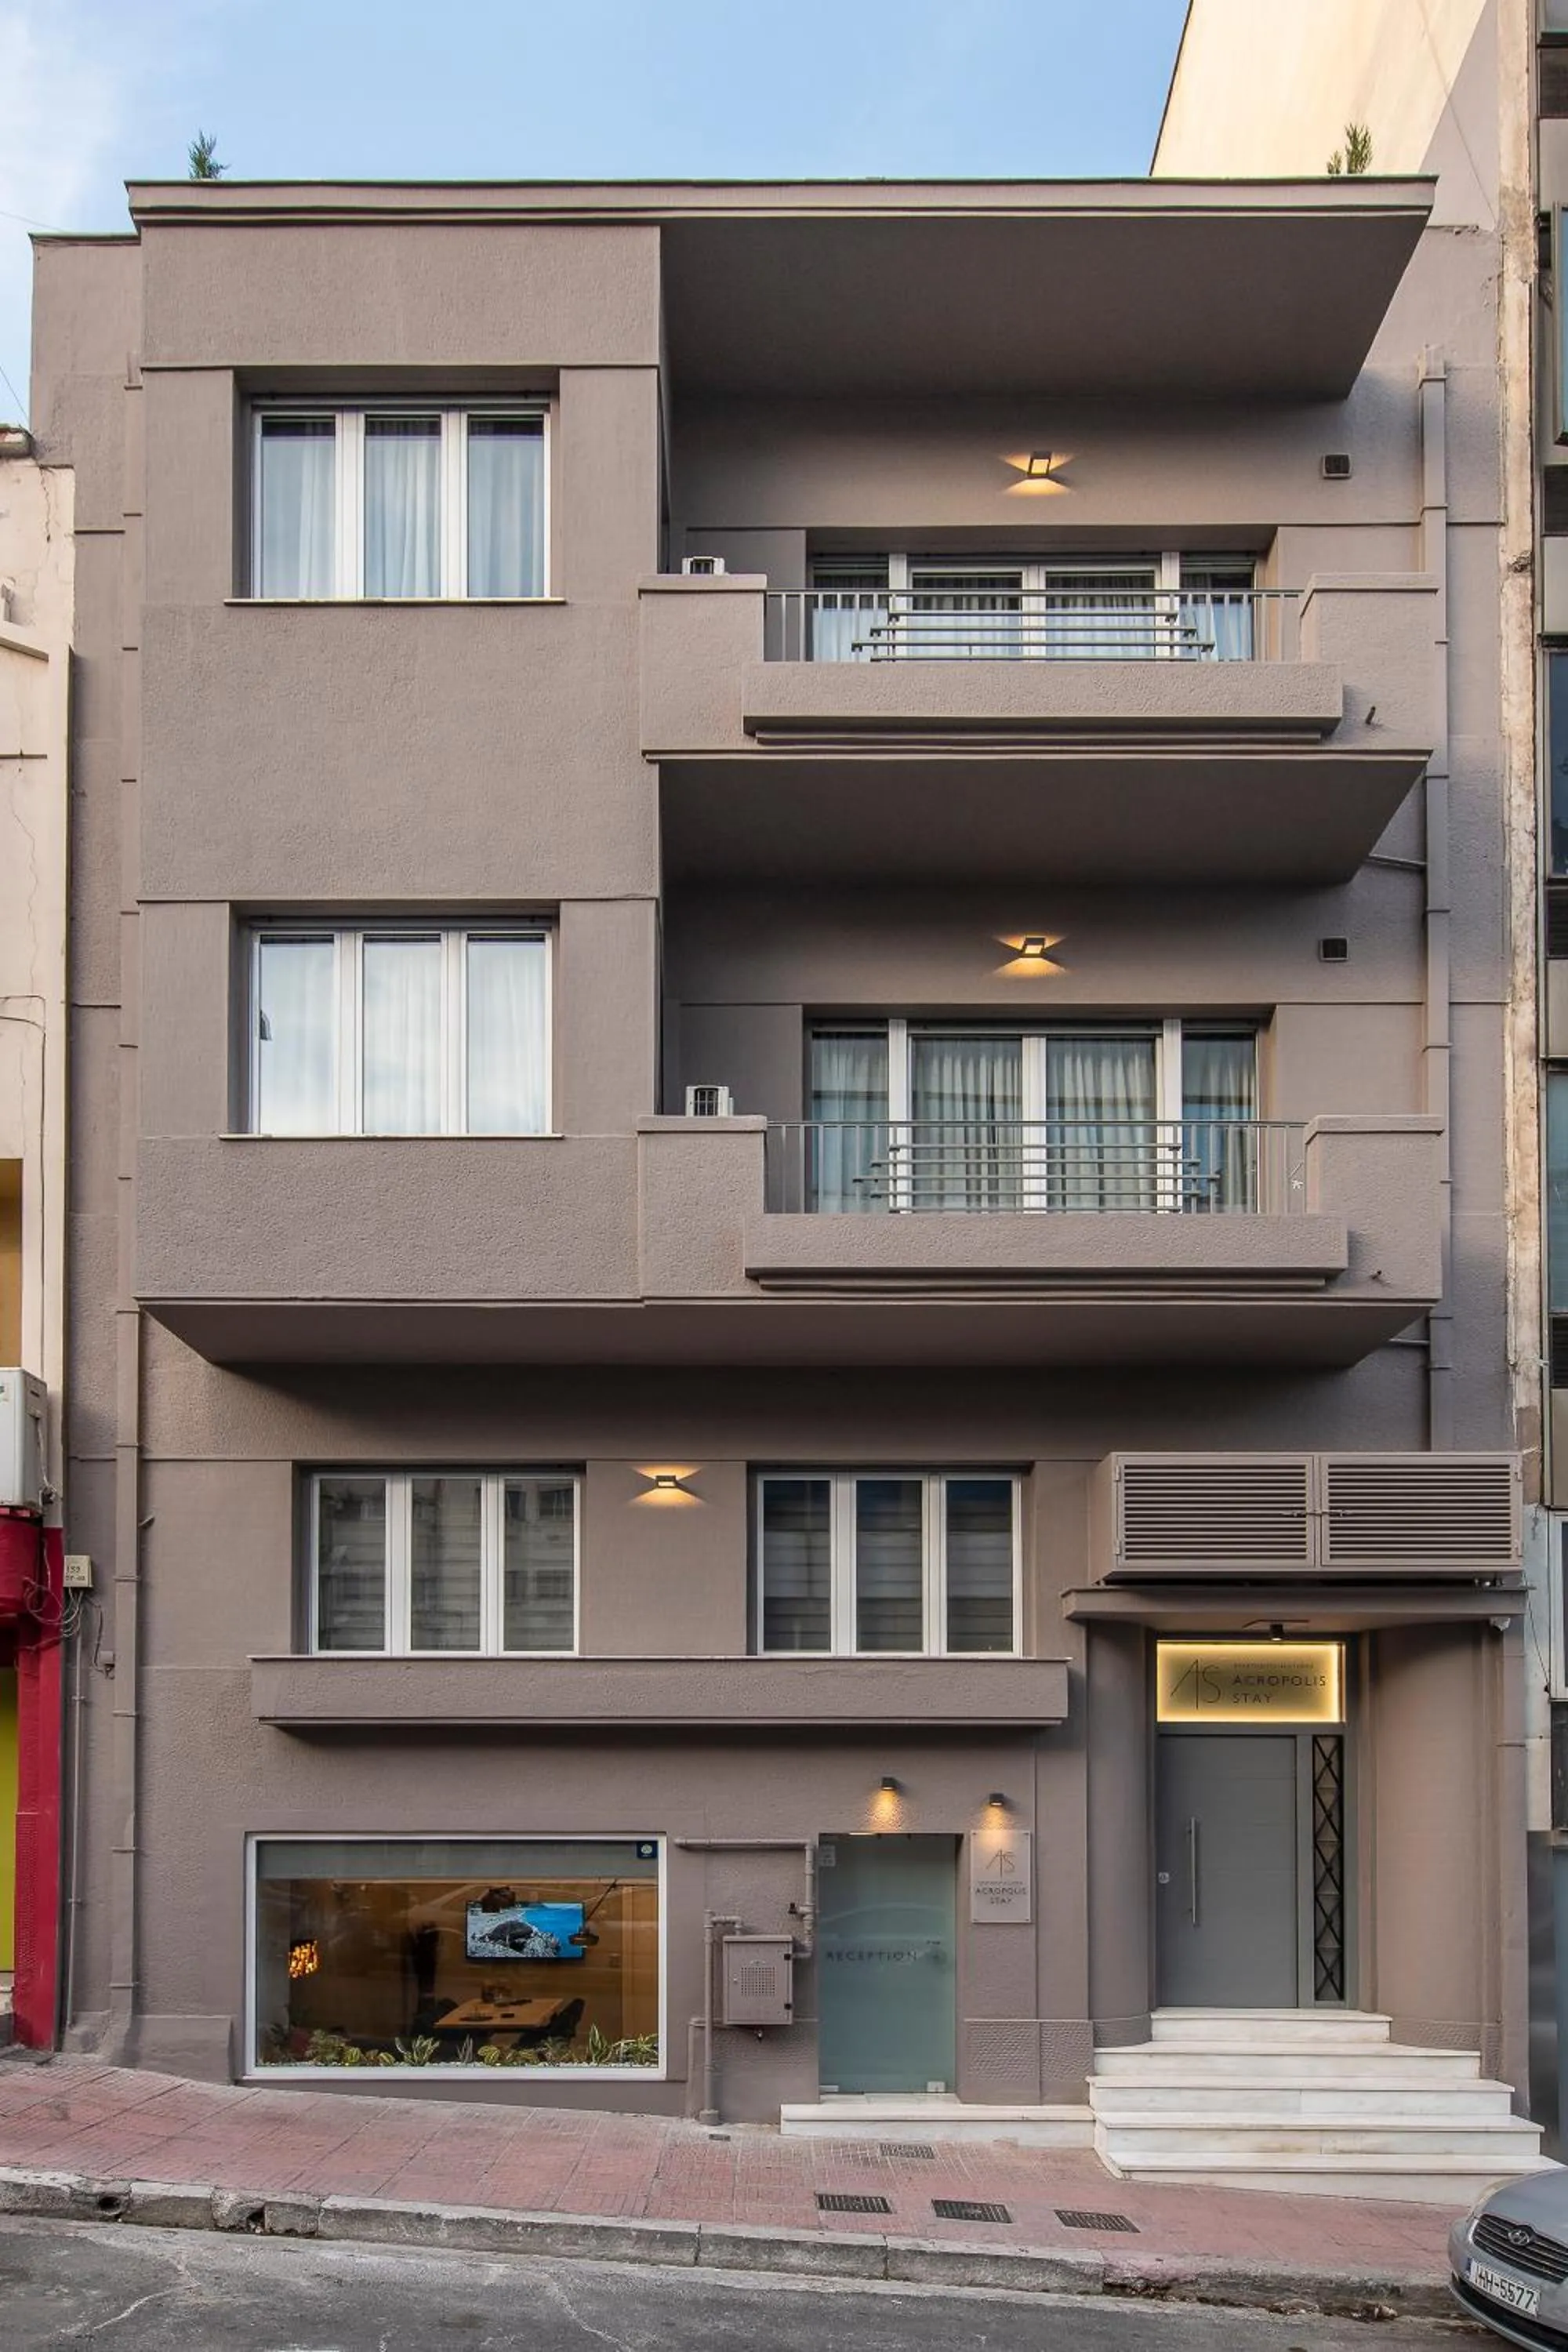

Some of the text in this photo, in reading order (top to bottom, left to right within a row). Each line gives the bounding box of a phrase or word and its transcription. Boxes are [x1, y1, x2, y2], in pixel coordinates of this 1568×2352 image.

[1232, 1675, 1327, 1686] ACROPOLIS
[1232, 1693, 1273, 1704] STAY
[975, 1887, 1027, 1896] ACROPOLIS
[826, 1951, 917, 1961] RECEPTION
